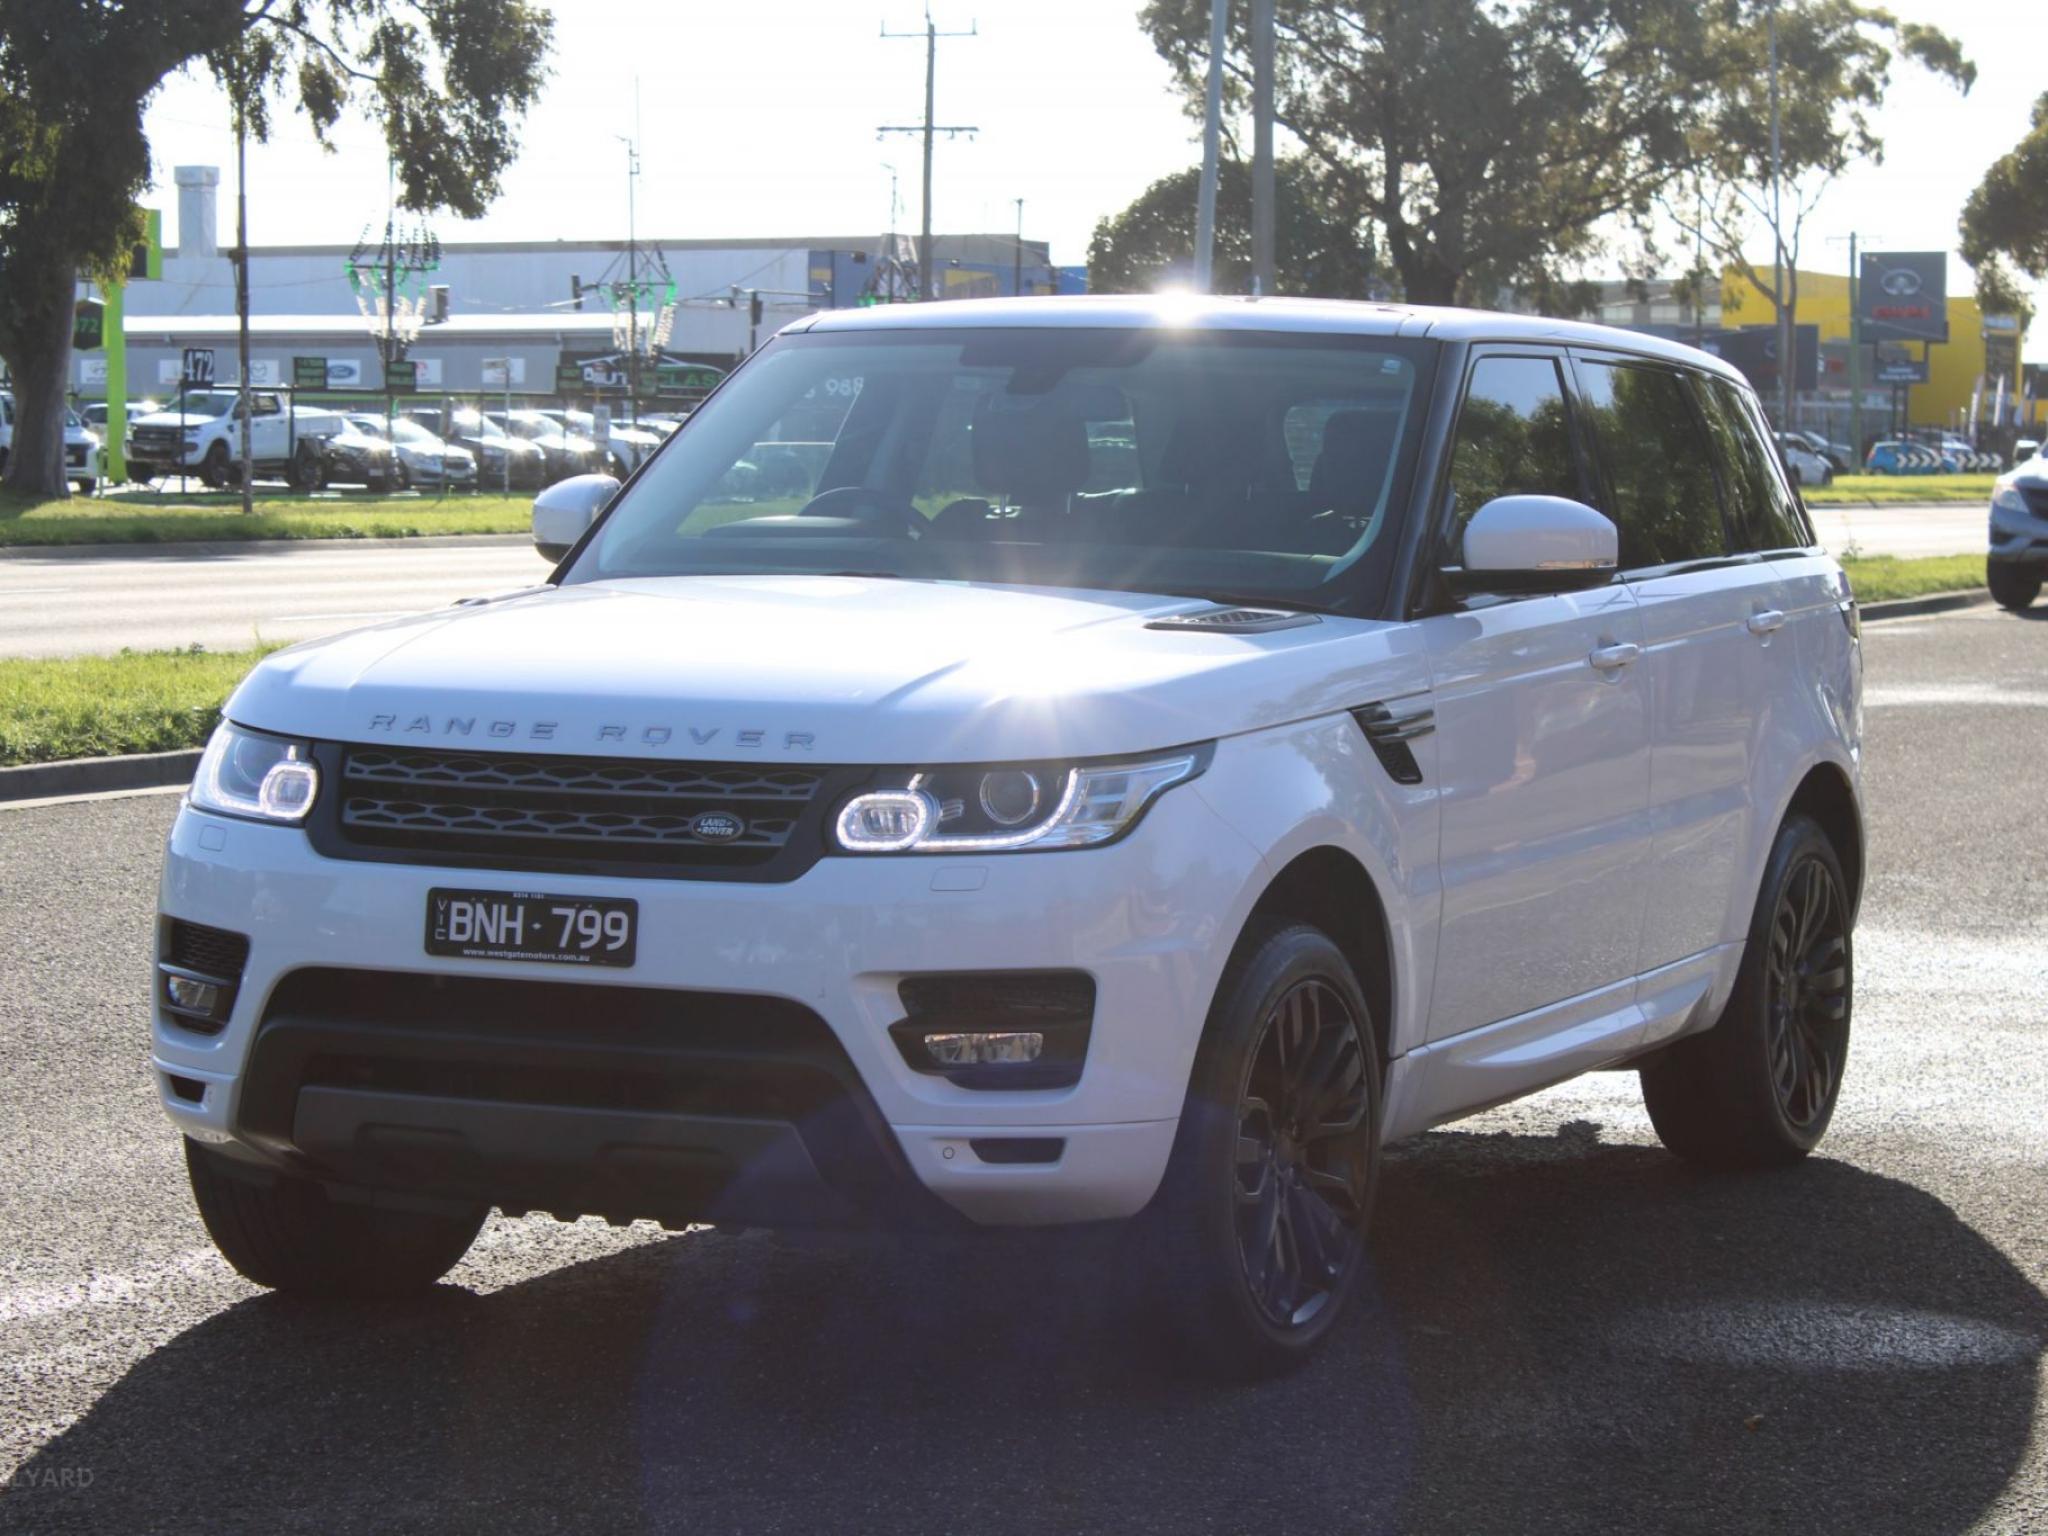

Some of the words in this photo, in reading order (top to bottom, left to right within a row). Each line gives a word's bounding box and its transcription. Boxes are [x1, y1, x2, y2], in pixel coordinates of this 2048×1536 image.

[185, 351, 213, 381] 472
[368, 713, 559, 740] RANGE
[598, 724, 817, 751] ROVER
[700, 818, 728, 827] LAND
[701, 826, 734, 836] ROVER
[434, 899, 447, 941] VIC
[449, 900, 525, 945] BNH
[551, 906, 629, 952] 799
